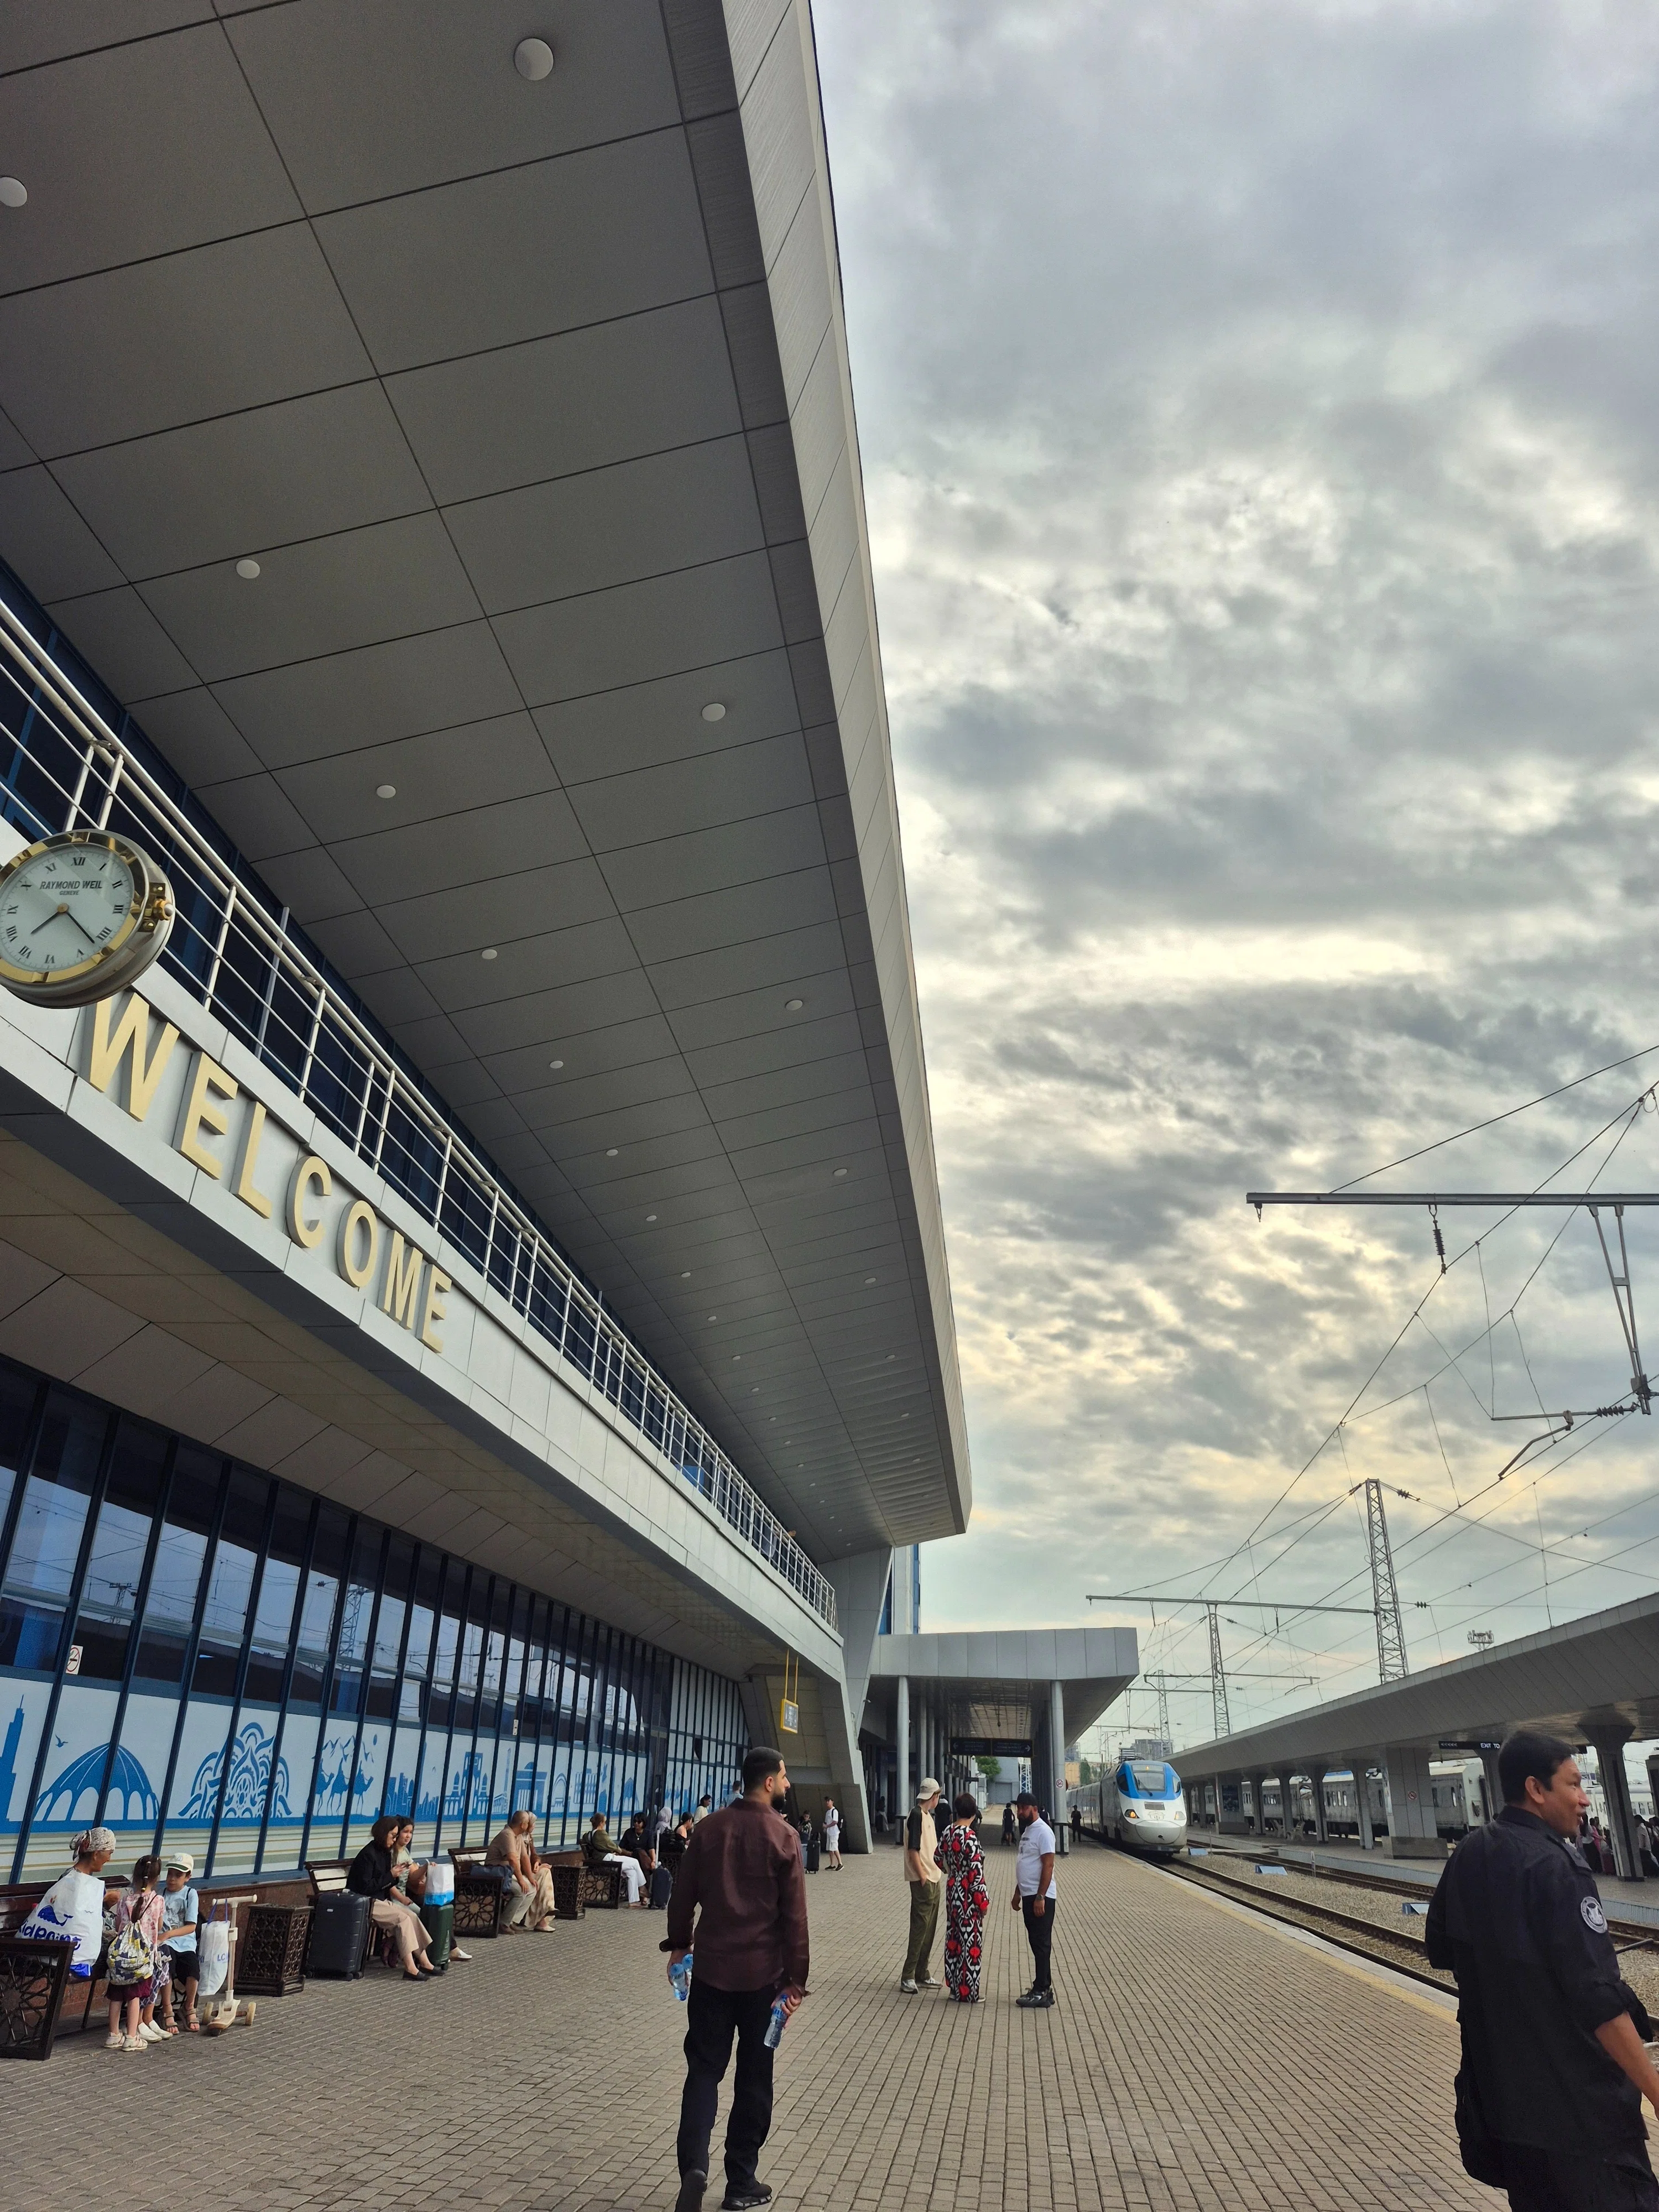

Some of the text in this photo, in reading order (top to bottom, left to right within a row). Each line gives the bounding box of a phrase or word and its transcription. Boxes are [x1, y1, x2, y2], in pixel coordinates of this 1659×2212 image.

[39, 880, 102, 889] RAYMOND WEIL
[86, 992, 452, 1354] WELCOME
